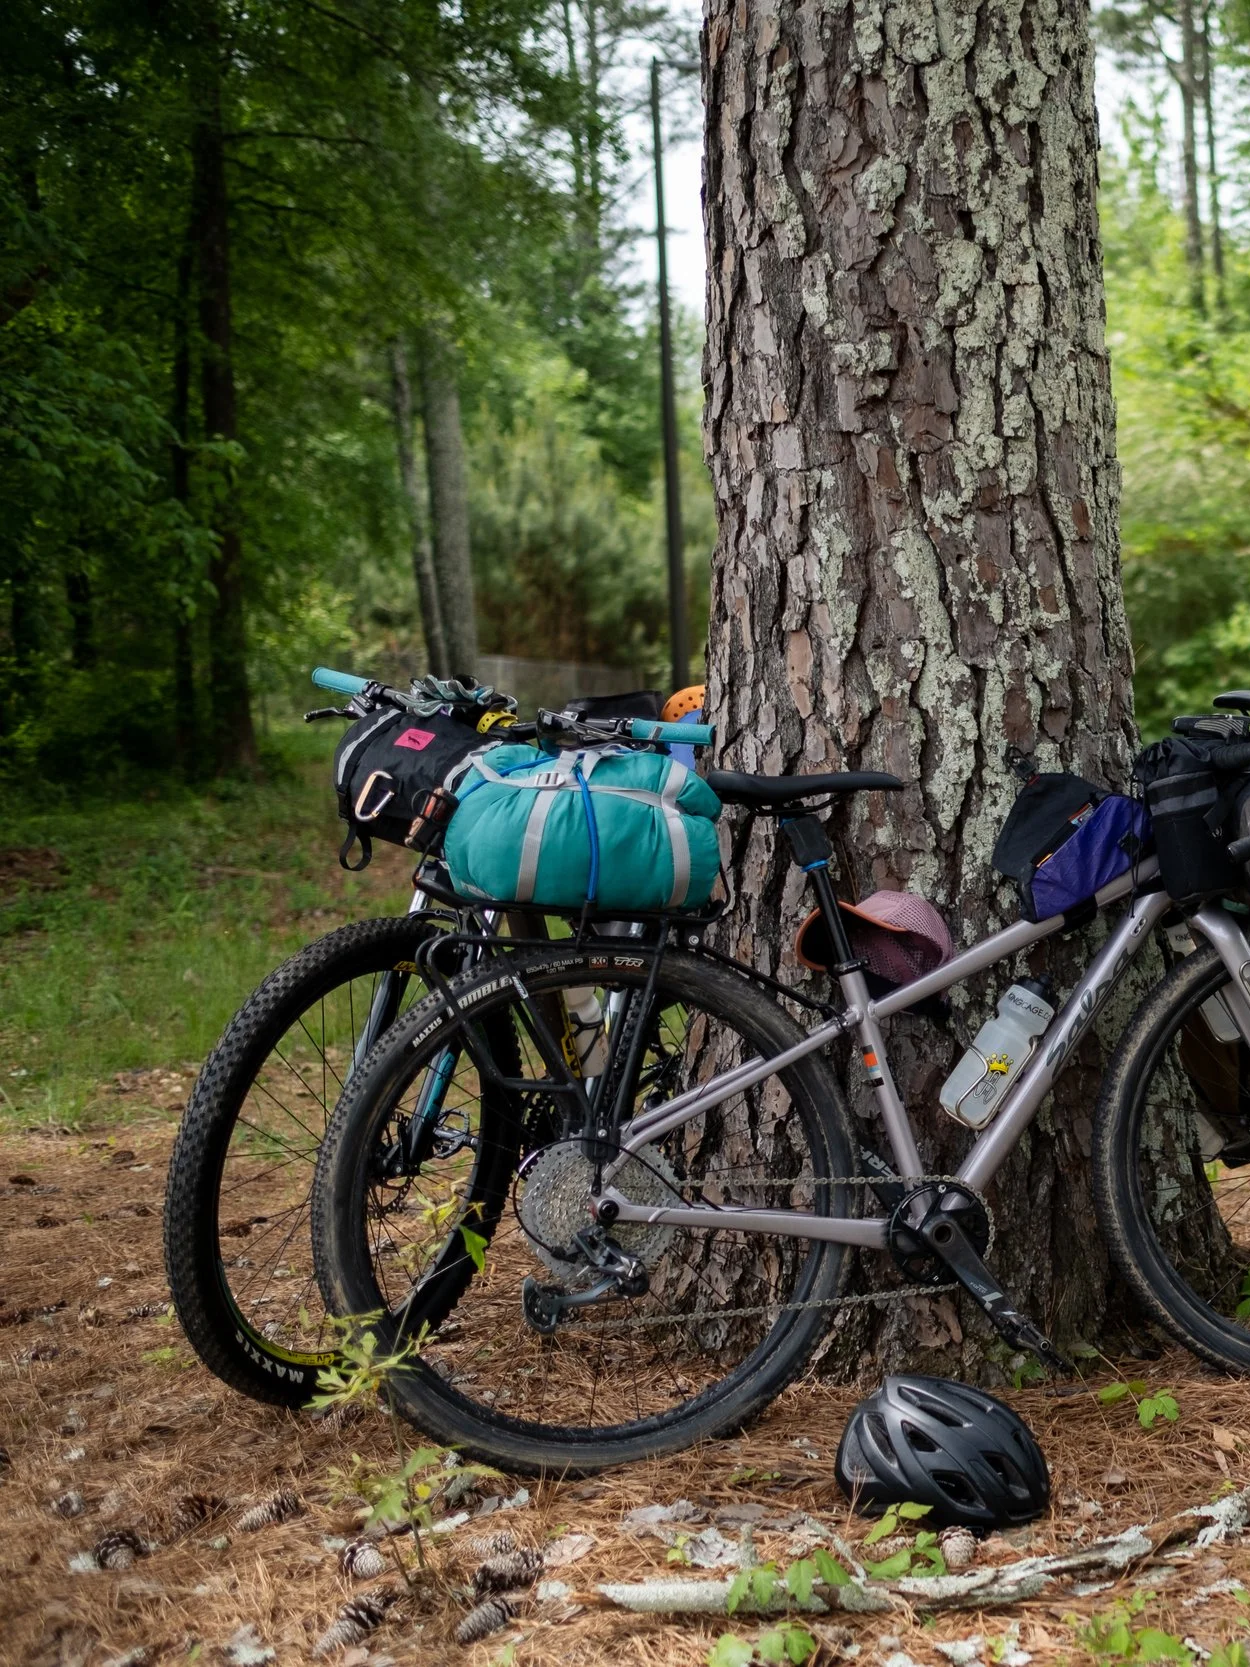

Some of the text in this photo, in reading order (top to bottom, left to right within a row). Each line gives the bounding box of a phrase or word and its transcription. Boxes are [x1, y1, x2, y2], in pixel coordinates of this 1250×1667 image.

[561, 959, 574, 967] MAX
[411, 1016, 443, 1048] MAXXIS
[235, 1329, 304, 1384] MAXXIS
